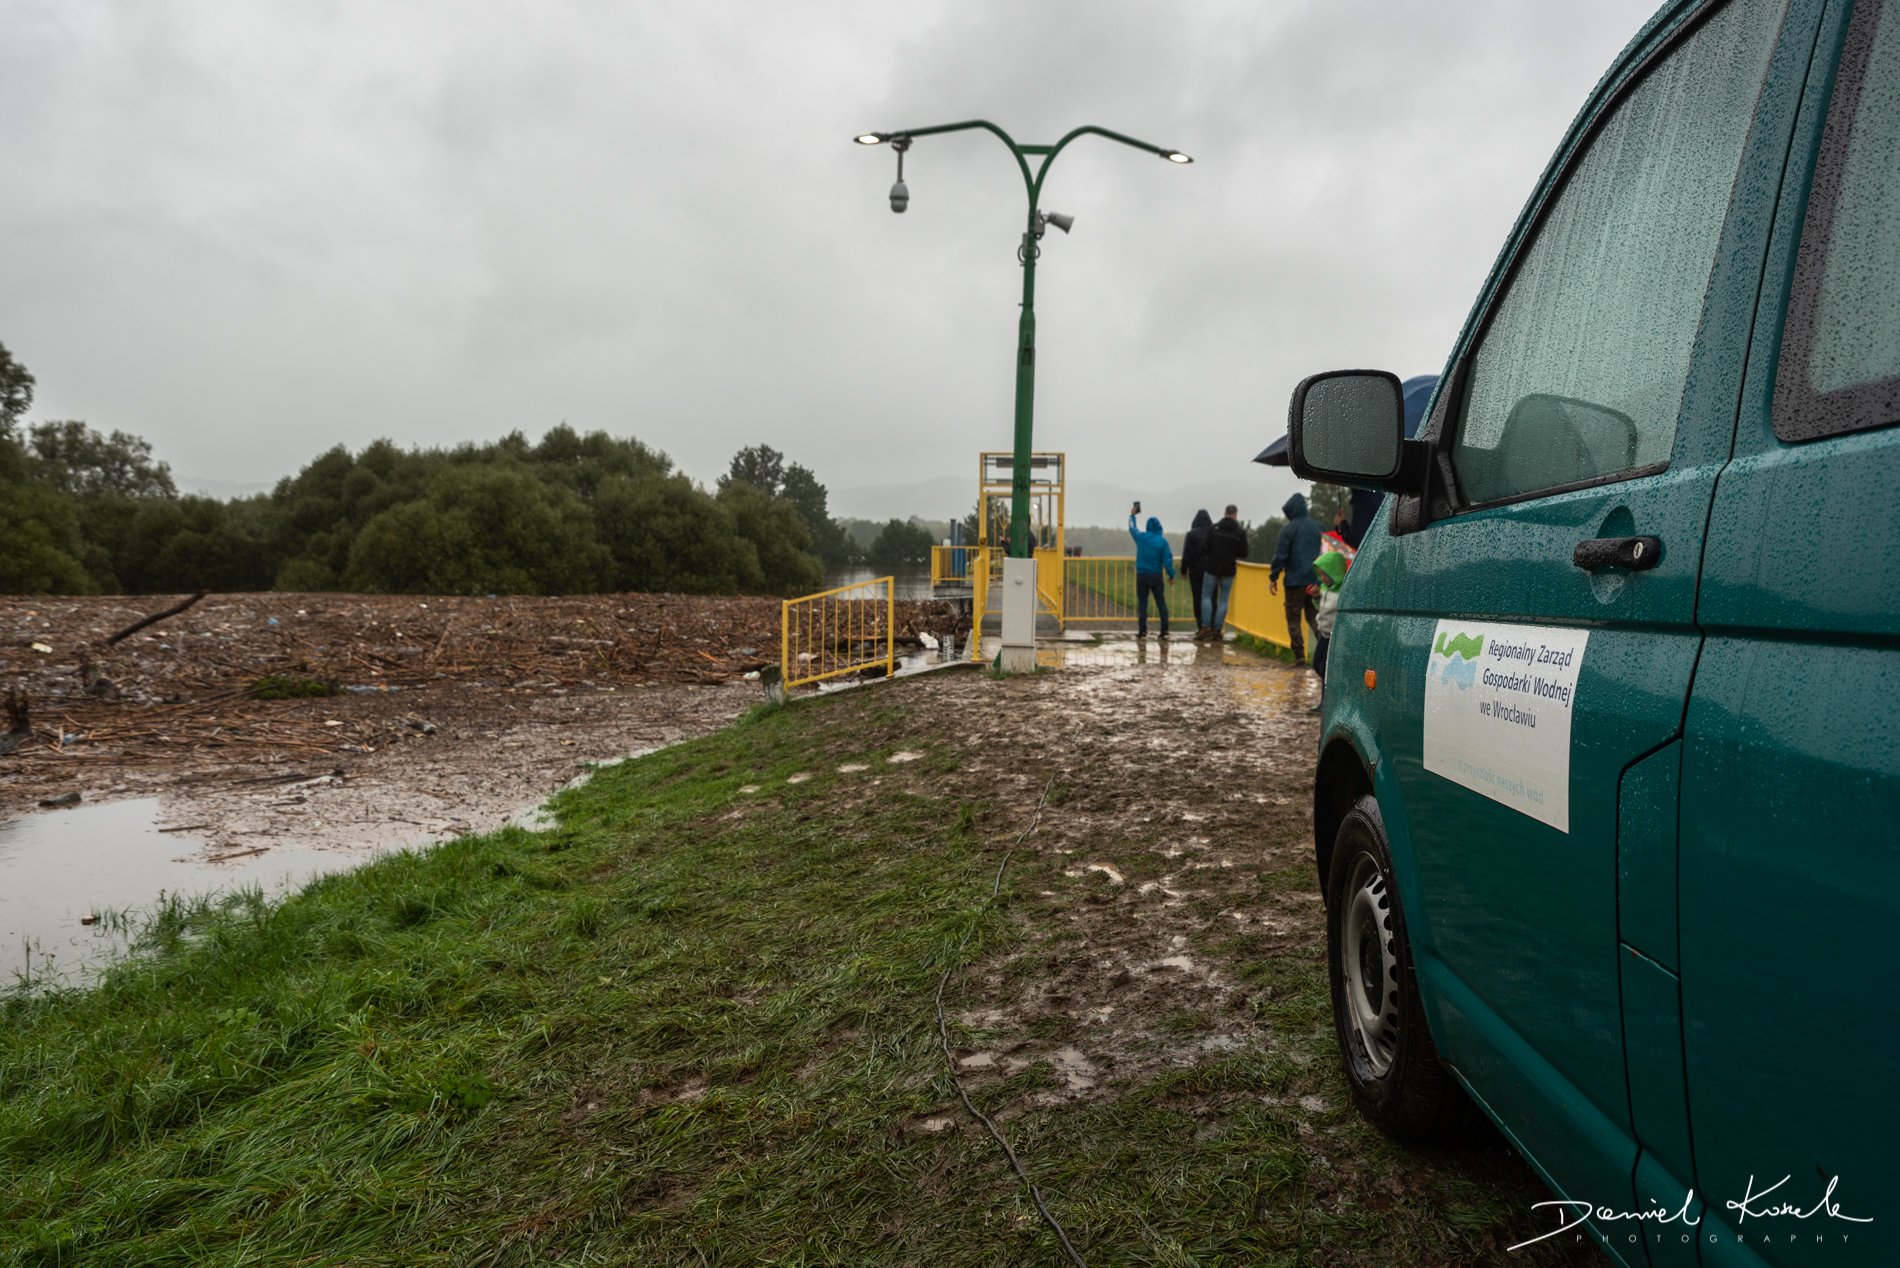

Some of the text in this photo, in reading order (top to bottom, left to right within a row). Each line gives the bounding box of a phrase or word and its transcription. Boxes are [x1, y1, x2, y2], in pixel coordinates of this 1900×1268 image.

[1488, 639, 1574, 671] Regionalny Zarząd
[1482, 668, 1572, 708] Gospodarki Wodnej
[1479, 701, 1536, 729] we Wrocławiu
[1496, 775, 1525, 797] naszych
[1527, 786, 1544, 804] wód
